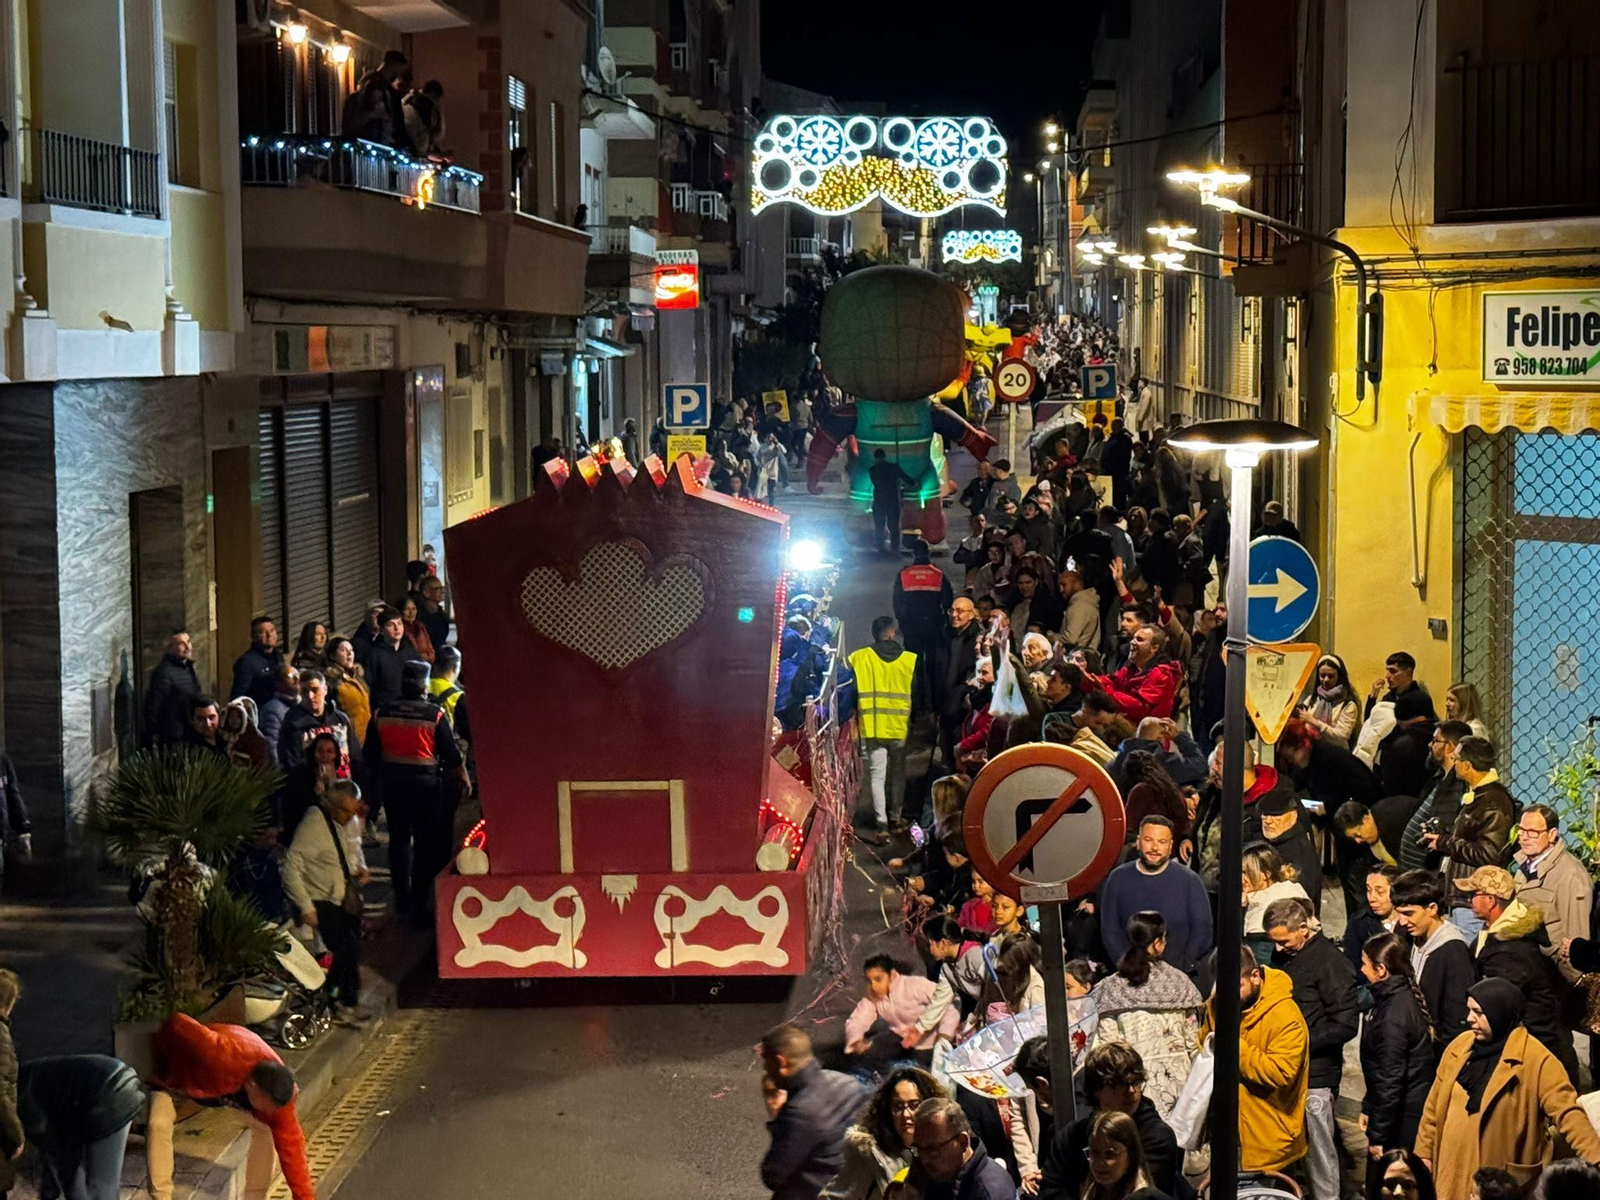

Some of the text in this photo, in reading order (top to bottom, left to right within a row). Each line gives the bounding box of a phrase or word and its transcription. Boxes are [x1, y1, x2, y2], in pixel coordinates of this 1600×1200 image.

[658, 251, 693, 259] BODEGAS
[1506, 306, 1600, 351] Felipe
[1513, 357, 1588, 375] 958 823 704
[1003, 373, 1027, 387] 20
[1088, 369, 1110, 397] P
[672, 389, 700, 424] P
